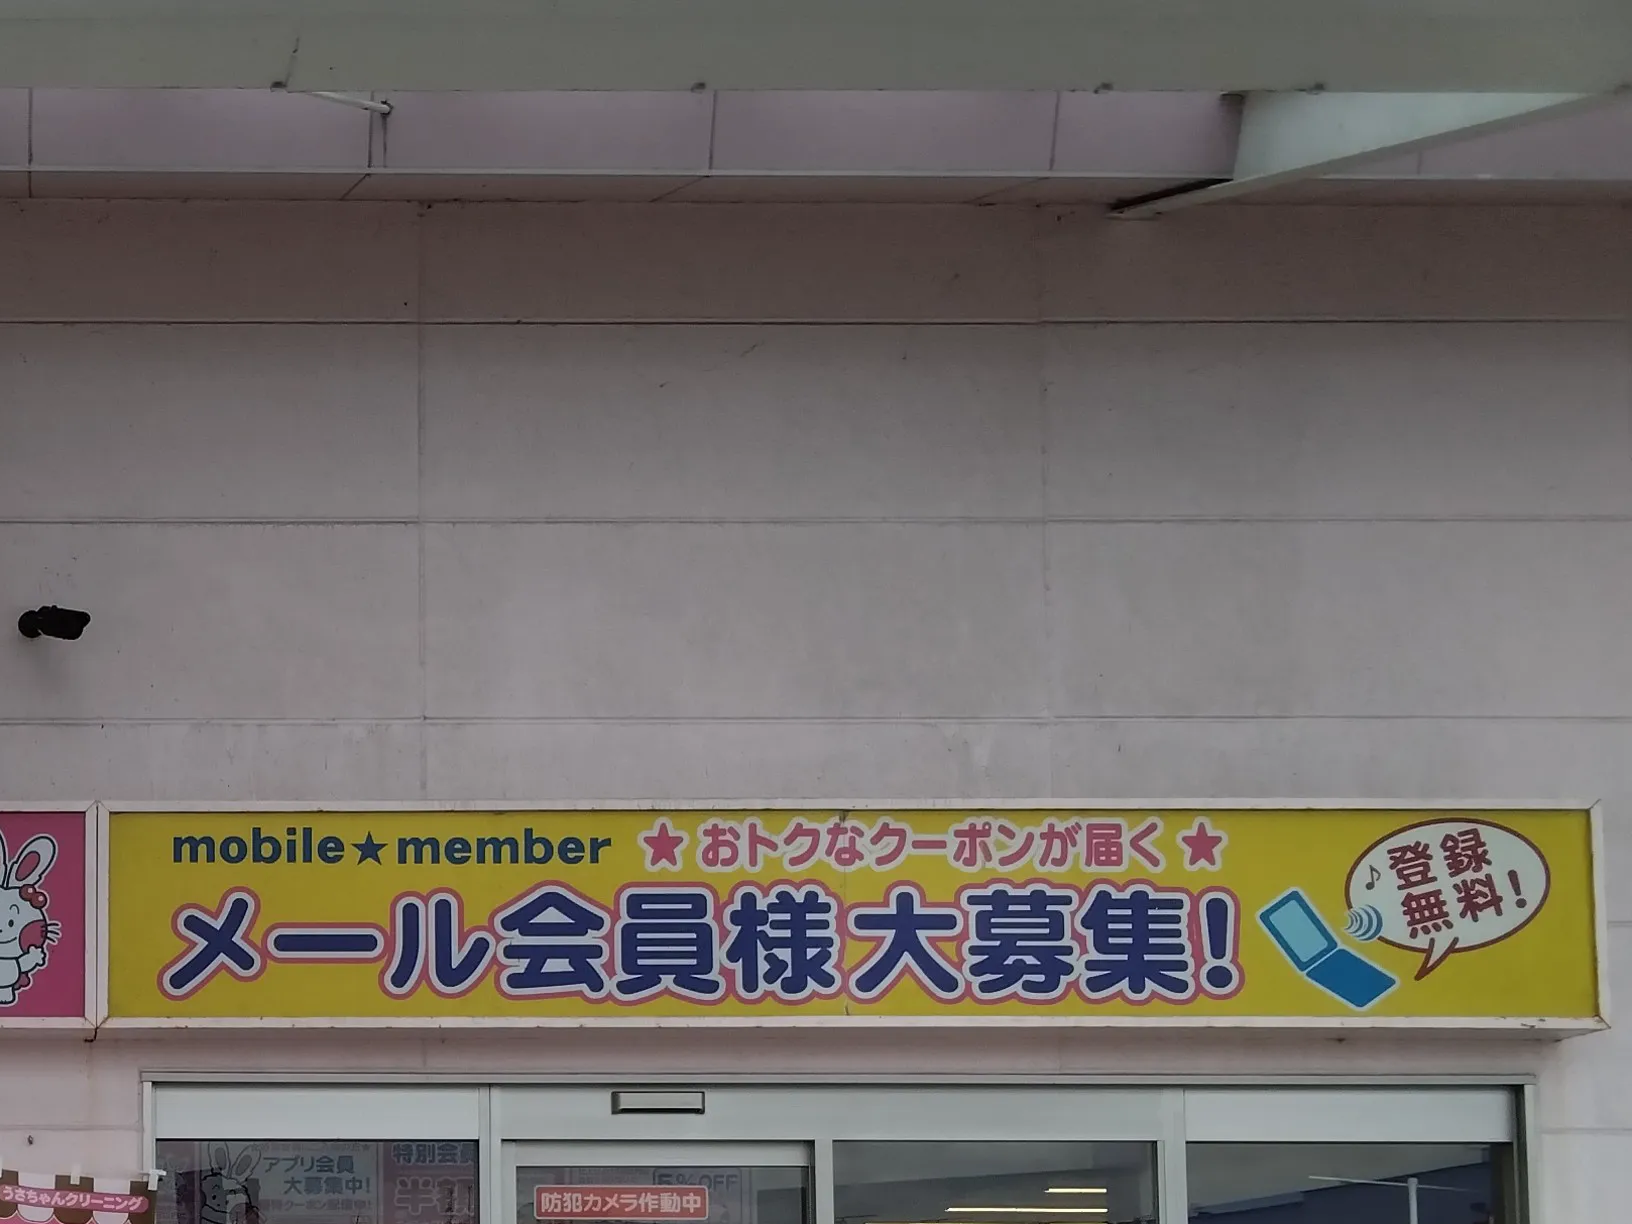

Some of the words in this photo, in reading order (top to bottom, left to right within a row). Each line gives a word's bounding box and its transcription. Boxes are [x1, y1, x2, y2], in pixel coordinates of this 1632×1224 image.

[173, 826, 345, 865] mobile
[397, 827, 612, 866] member
[700, 820, 1162, 870] おトクなクーポンが届く
[1387, 828, 1487, 890] 登録
[1402, 874, 1528, 938] 無料!
[167, 887, 1232, 995] メール会員様大募集!
[264, 1155, 355, 1174] アプリ会員
[2, 1186, 144, 1212] うさちゃんクリーニング
[540, 1192, 702, 1214] 防犯カメラ作動中
